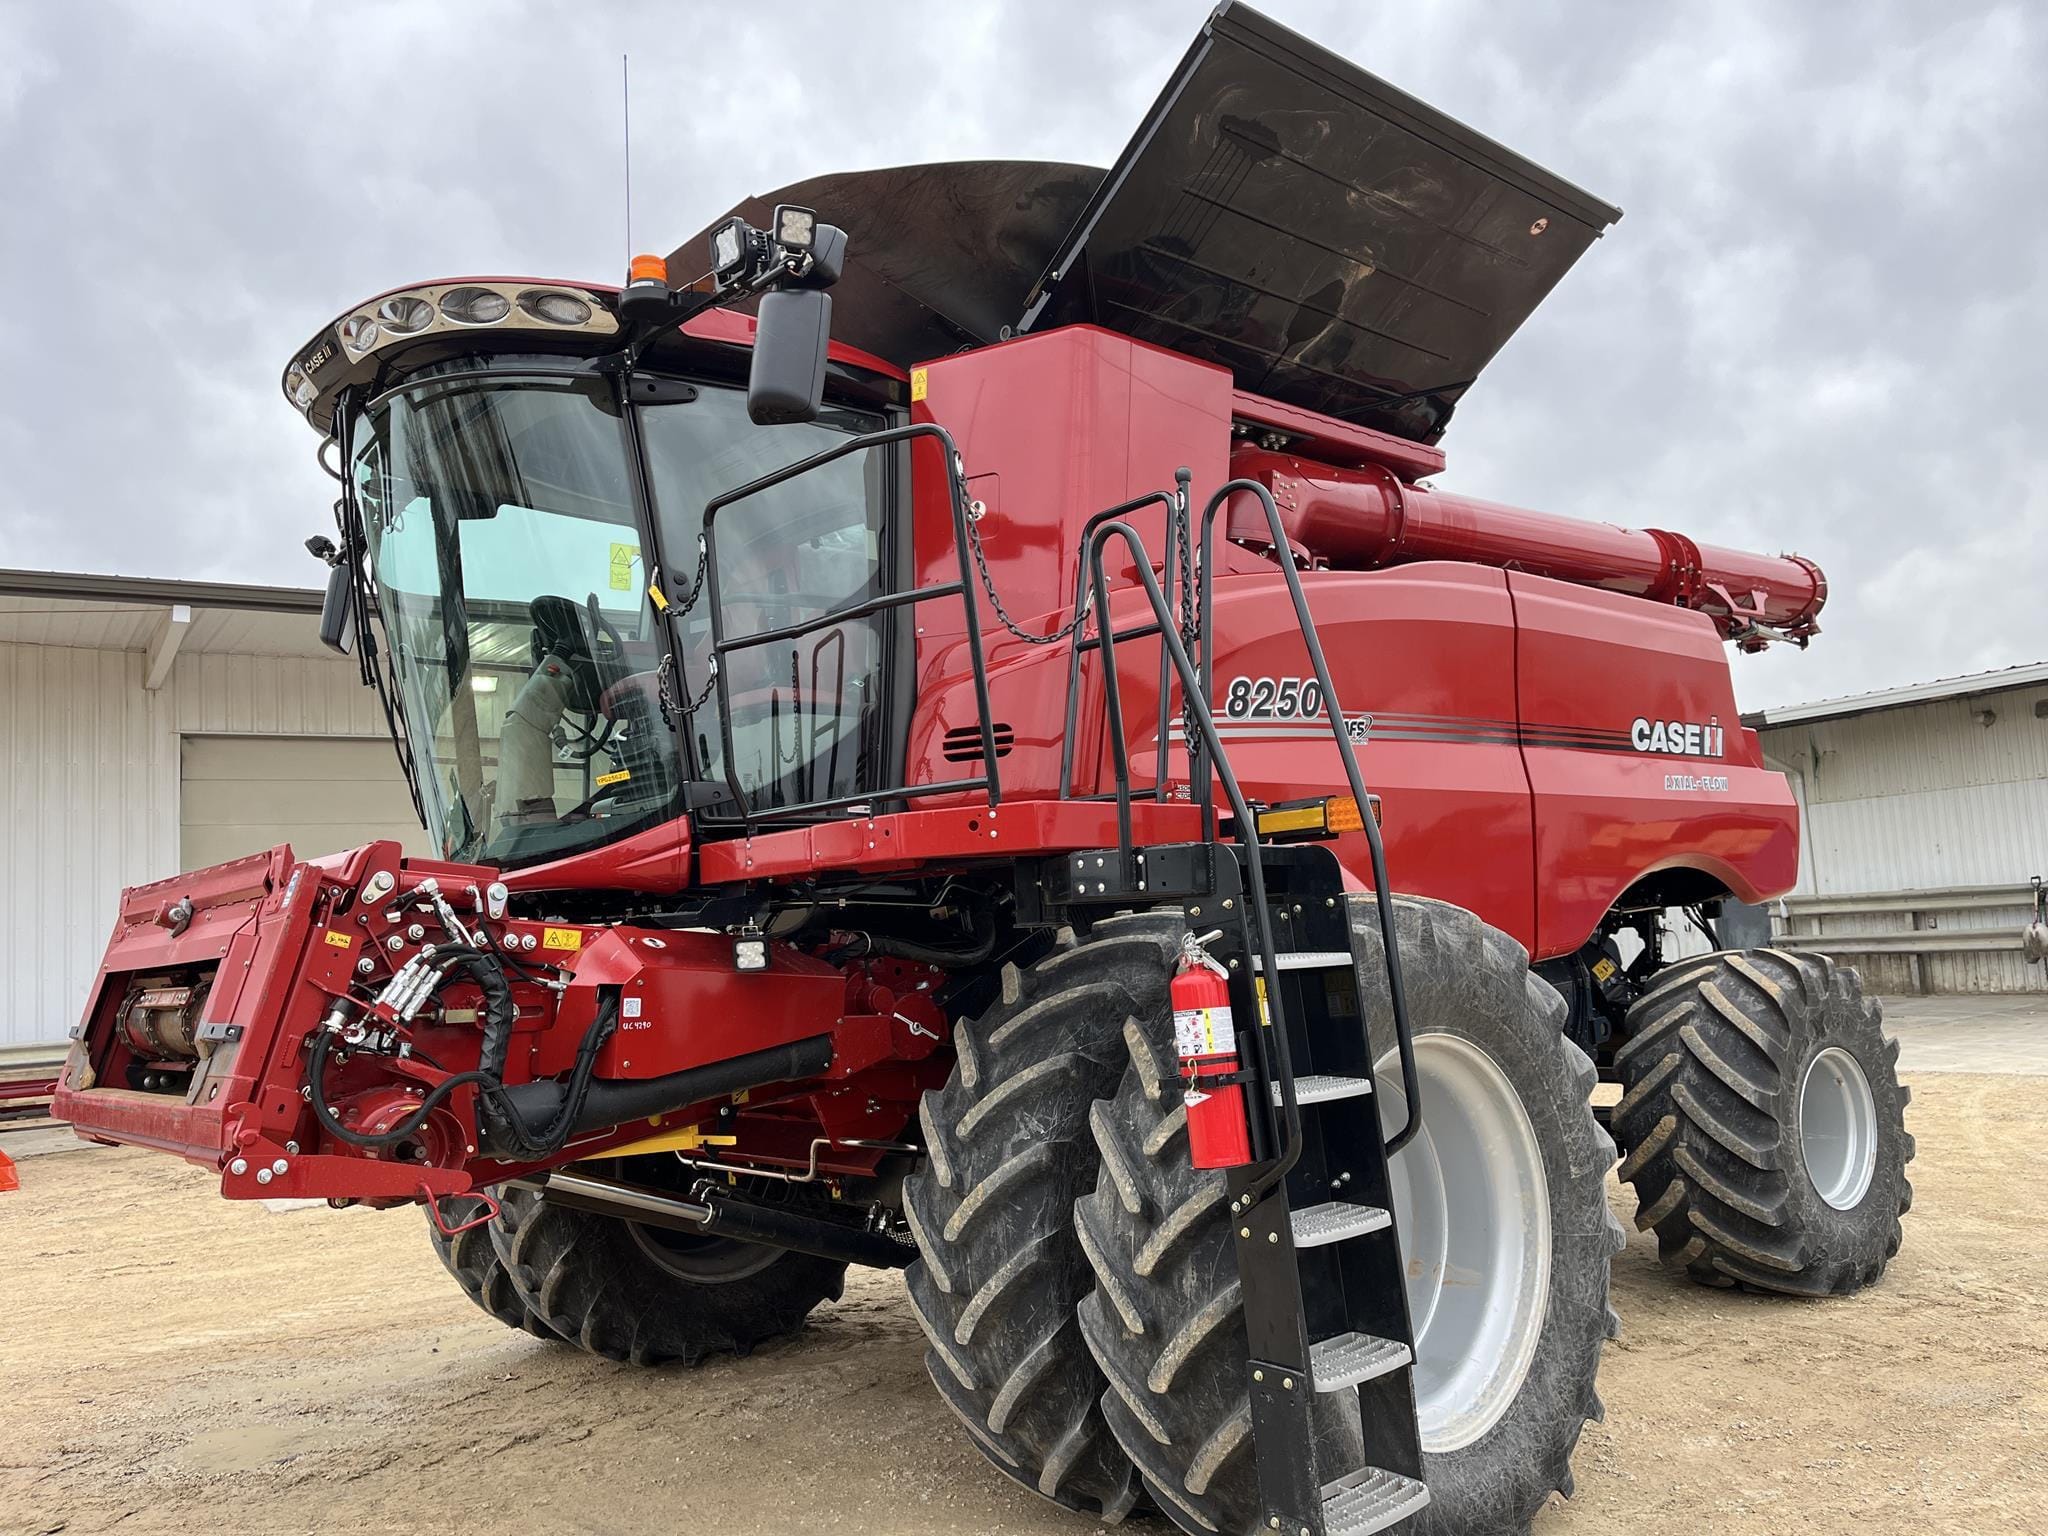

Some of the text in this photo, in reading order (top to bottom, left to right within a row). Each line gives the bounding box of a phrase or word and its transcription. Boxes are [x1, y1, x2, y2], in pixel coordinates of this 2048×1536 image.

[305, 351, 325, 374] CASE
[1226, 676, 1321, 720] 8250
[1631, 717, 1701, 755] CASE
[1665, 775, 1728, 791] AXIAL-FLOW
